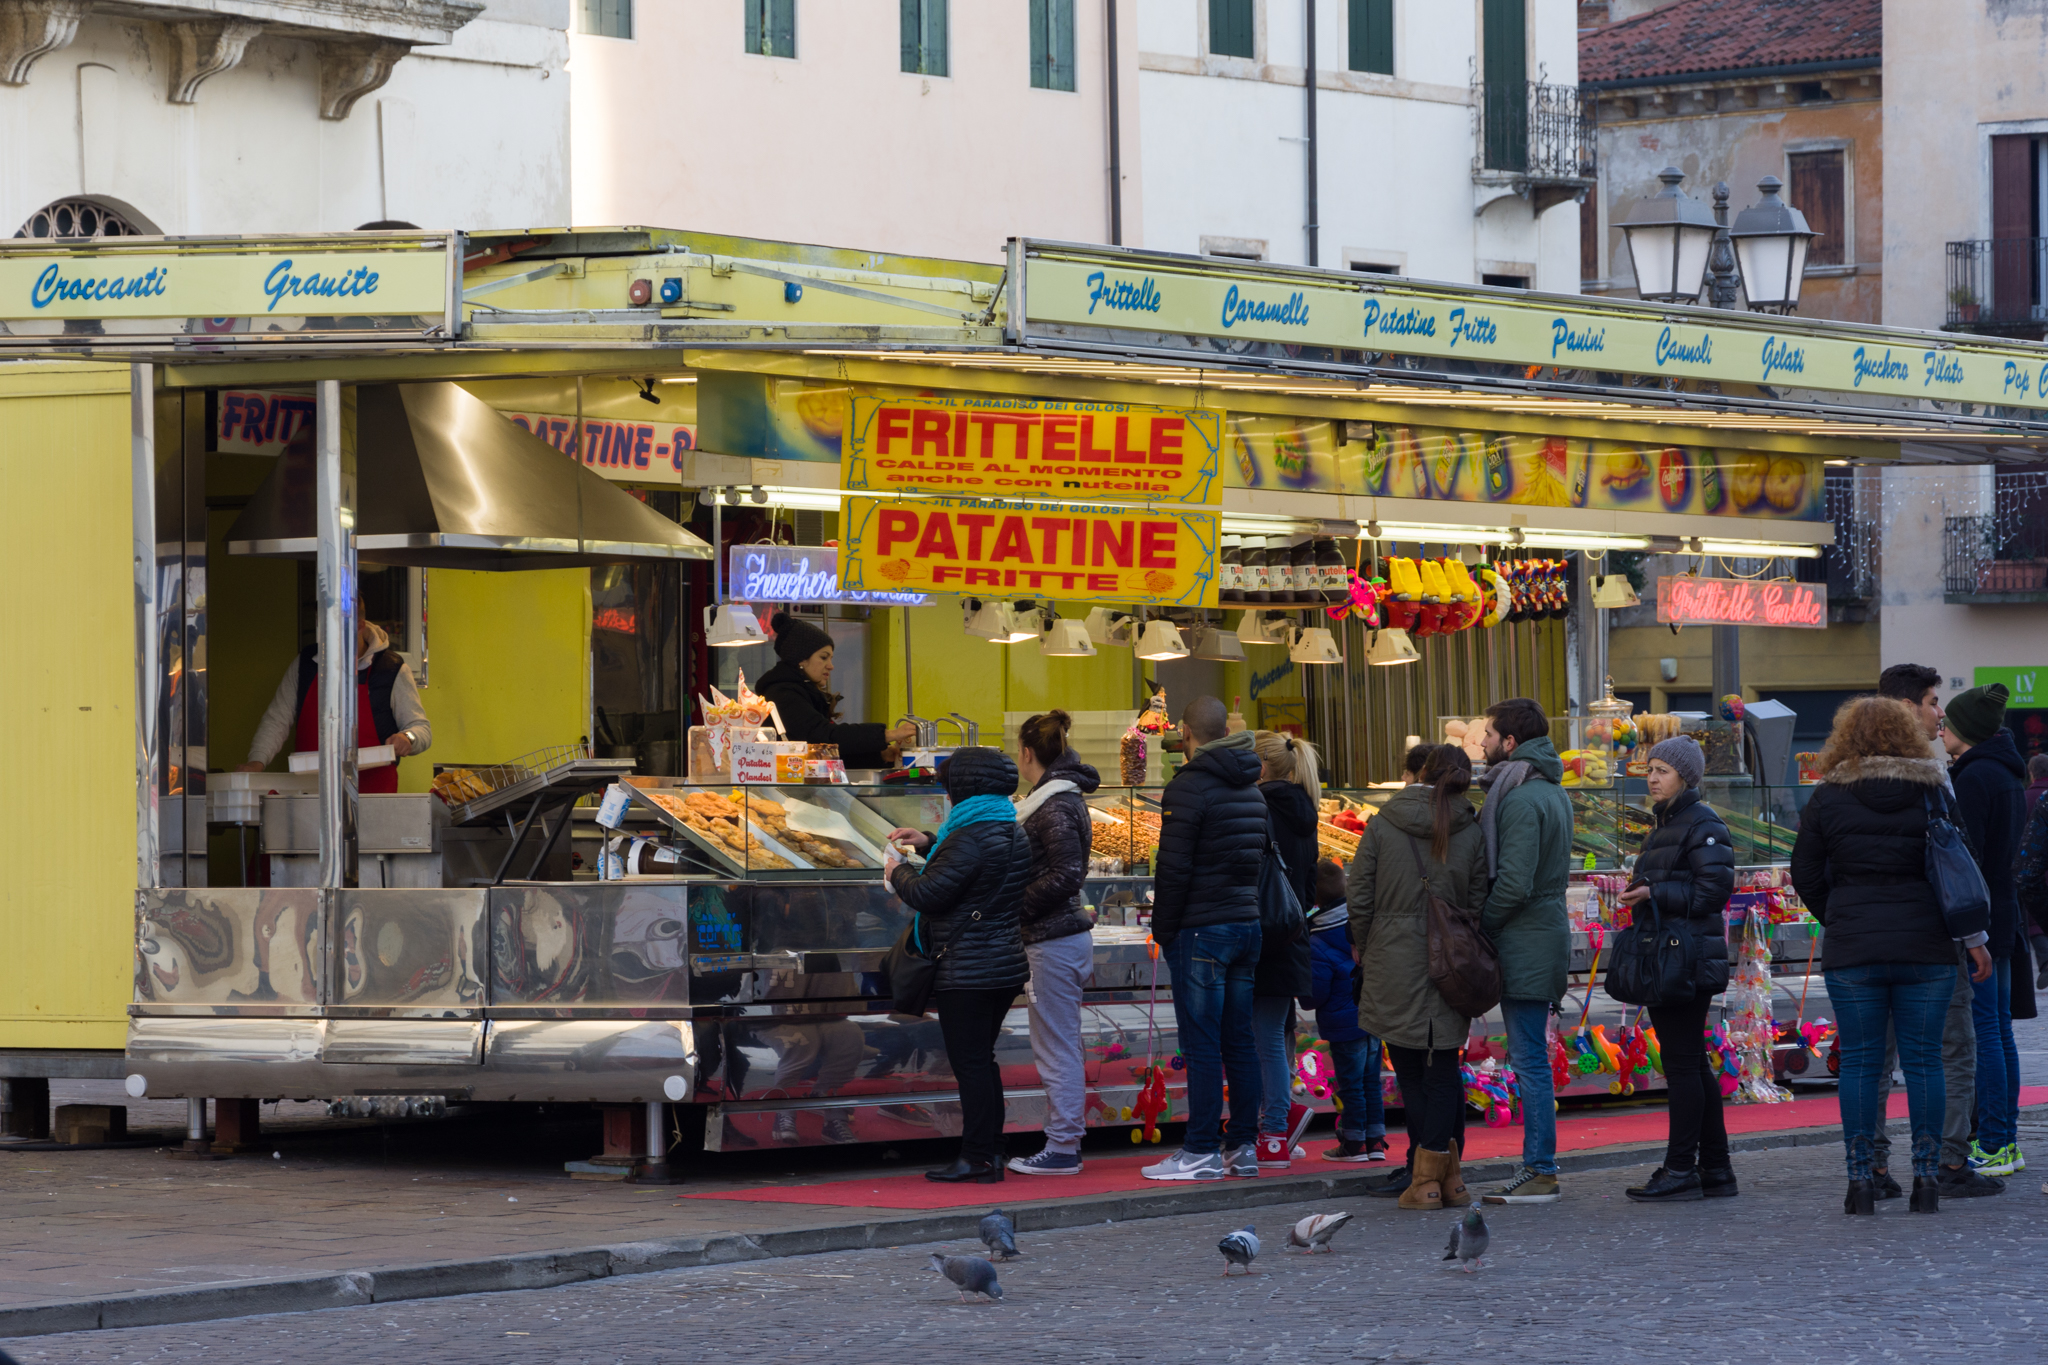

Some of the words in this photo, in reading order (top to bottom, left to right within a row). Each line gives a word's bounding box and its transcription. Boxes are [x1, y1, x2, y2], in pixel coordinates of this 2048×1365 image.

[32, 263, 167, 309] Croccanti
[264, 259, 379, 312] Granite
[1086, 271, 1161, 315] Frittelle
[1222, 284, 1309, 328] Caramelle
[1363, 299, 1437, 338] Patatine
[1449, 307, 1497, 348] Fritte
[1552, 317, 1604, 359] Panini
[1655, 326, 1712, 366] Cannoli
[1761, 335, 1805, 381] Gelati
[1853, 346, 1909, 388] Zucchero
[1924, 351, 1965, 387] Filato
[2003, 360, 2030, 402] Pop
[944, 398, 957, 408] IL
[964, 399, 1038, 411] PARADISO
[1044, 401, 1069, 412] DEI
[1073, 402, 1131, 414] GOLOSI
[876, 408, 1185, 465] FRITTELLE
[875, 459, 975, 473] CALDE
[983, 463, 1021, 475] AL
[1030, 464, 1182, 480] MOMENTO
[886, 473, 983, 485] anche
[994, 477, 1052, 488] con
[1063, 479, 1170, 493] nutella
[940, 498, 952, 508] IL
[959, 499, 1033, 512] PARADISO
[1039, 502, 1064, 513] DEI
[1068, 503, 1126, 515] GOLOSI
[877, 509, 1177, 569] PATATINE
[932, 566, 1119, 592] FRITTE
[2015, 695, 2035, 704] BAR
